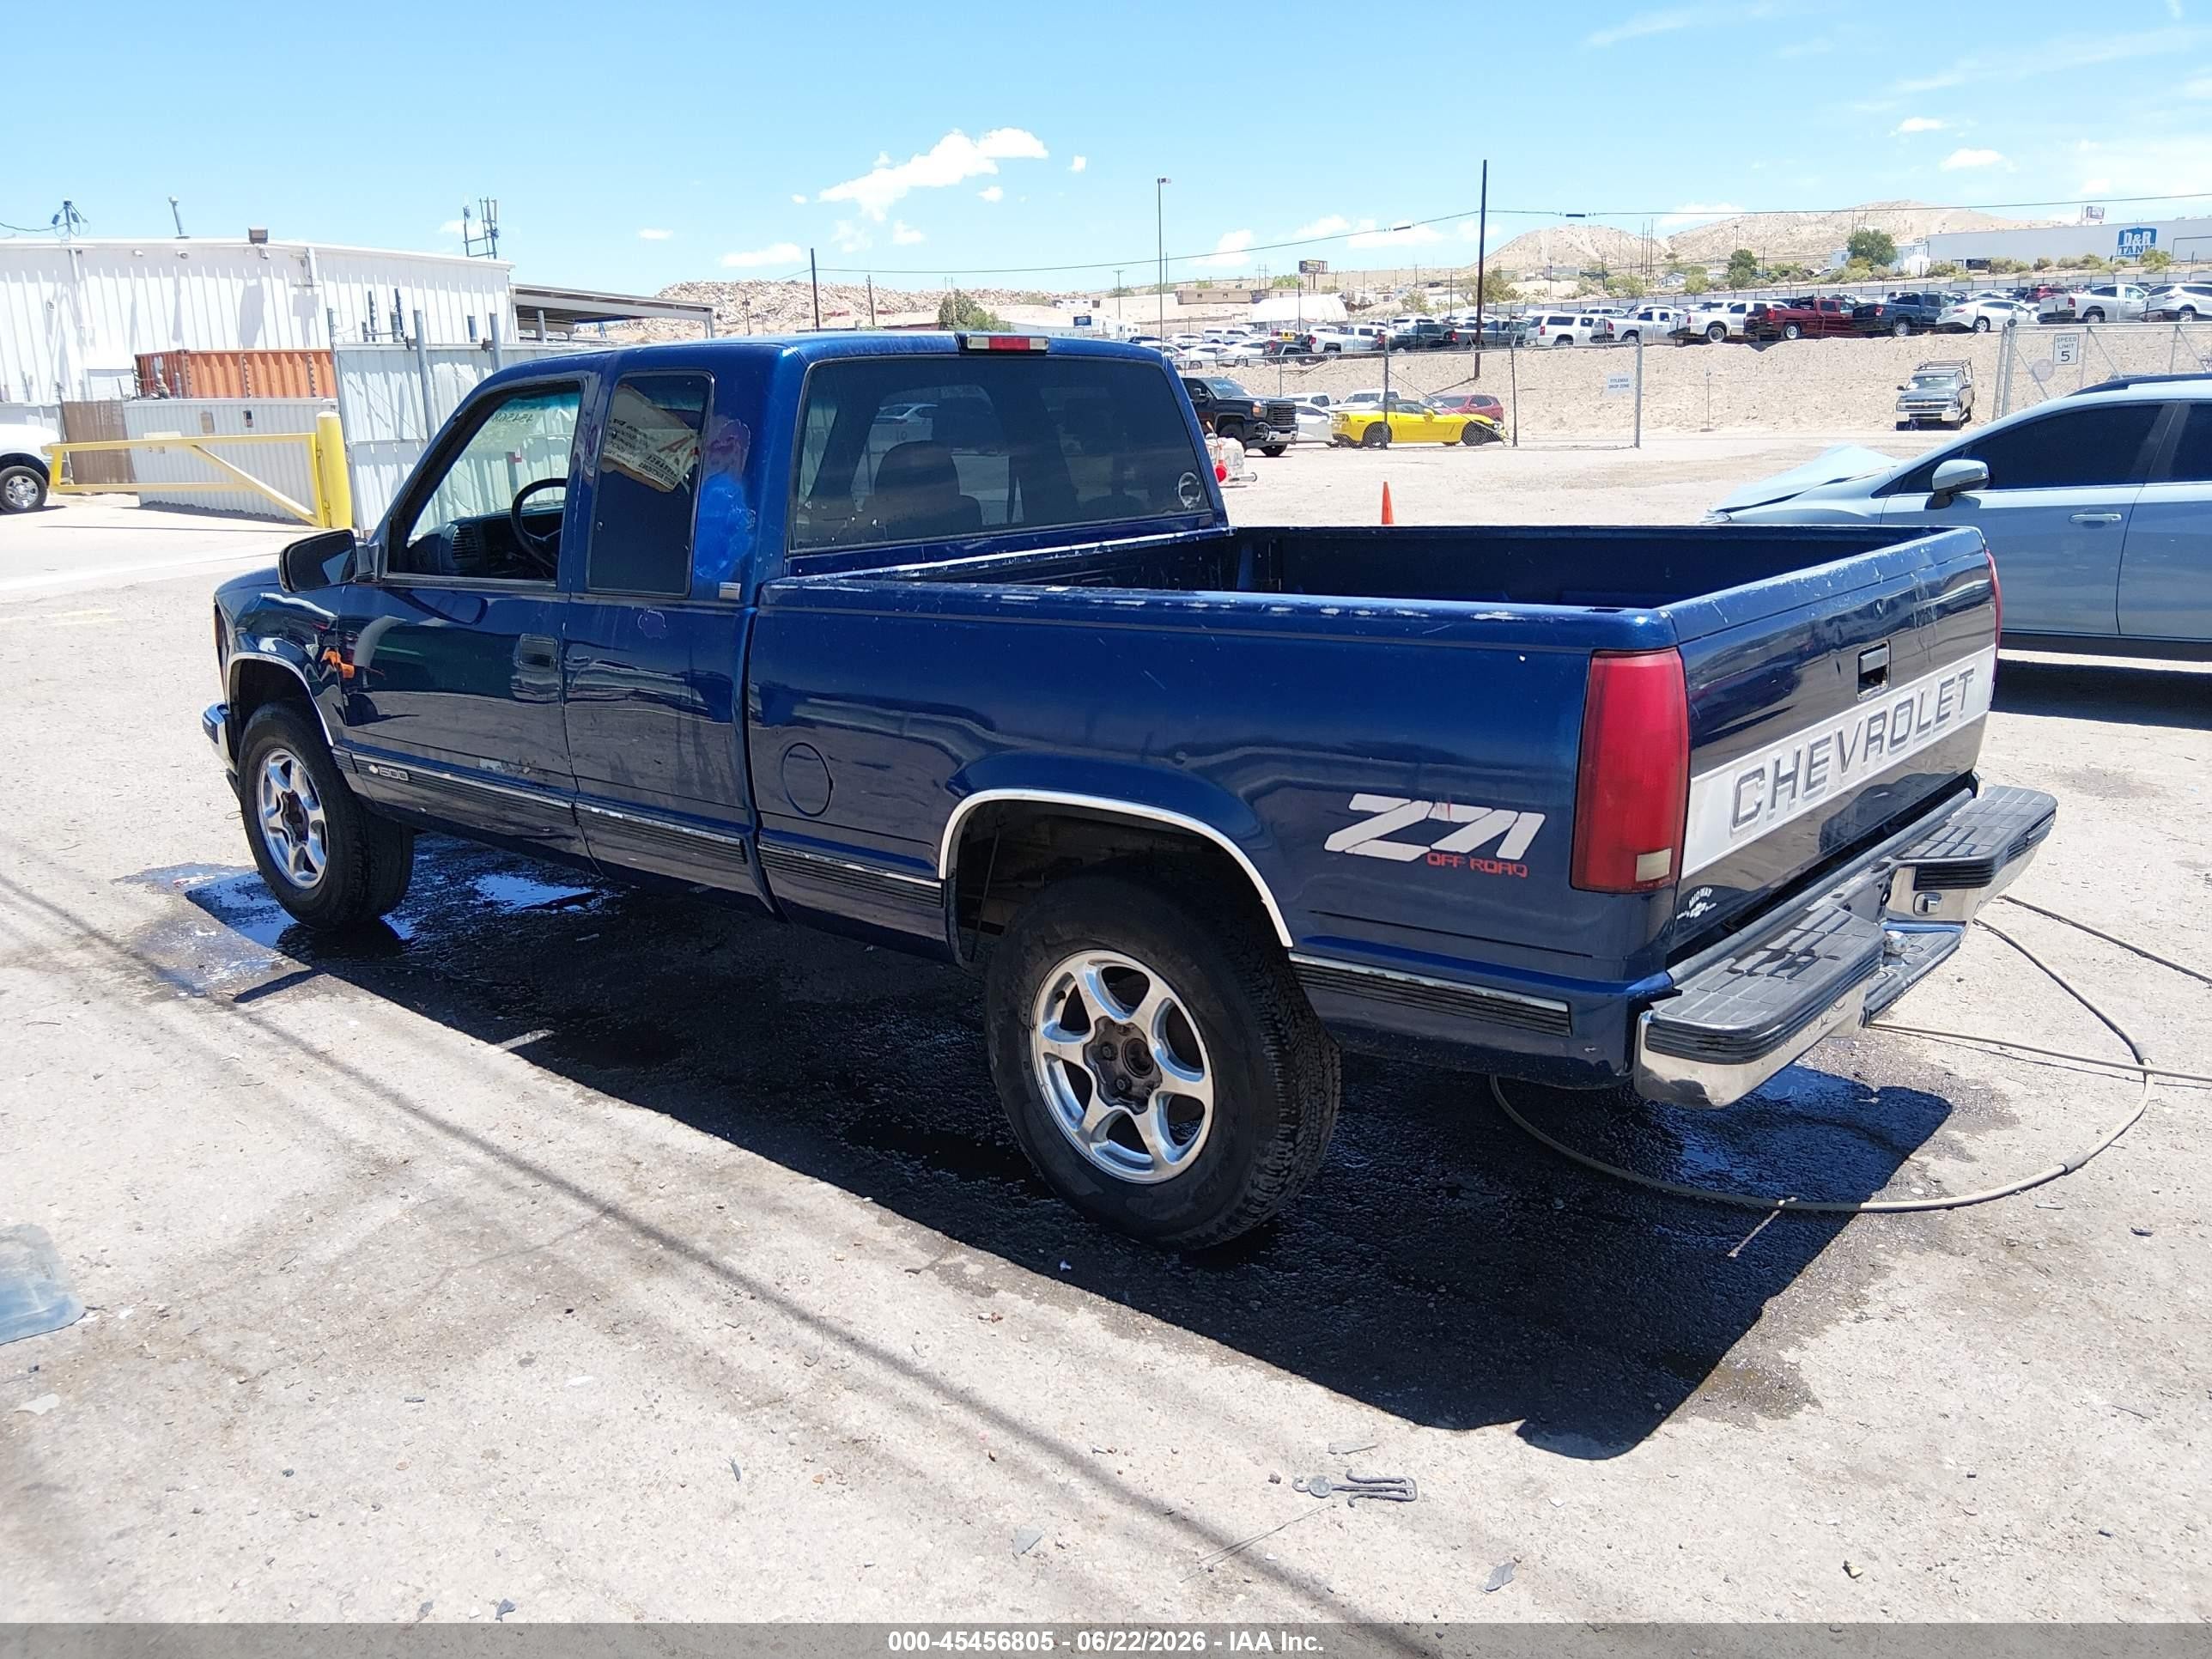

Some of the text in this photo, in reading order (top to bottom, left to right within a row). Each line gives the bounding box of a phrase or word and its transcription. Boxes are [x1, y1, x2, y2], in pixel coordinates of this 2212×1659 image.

[2124, 231, 2152, 246] D&R
[2060, 350, 2070, 362] 5
[1731, 665, 1976, 833] CHEVROLET
[1323, 793, 1546, 862] Z71
[1426, 852, 1529, 878] OFF ROAD
